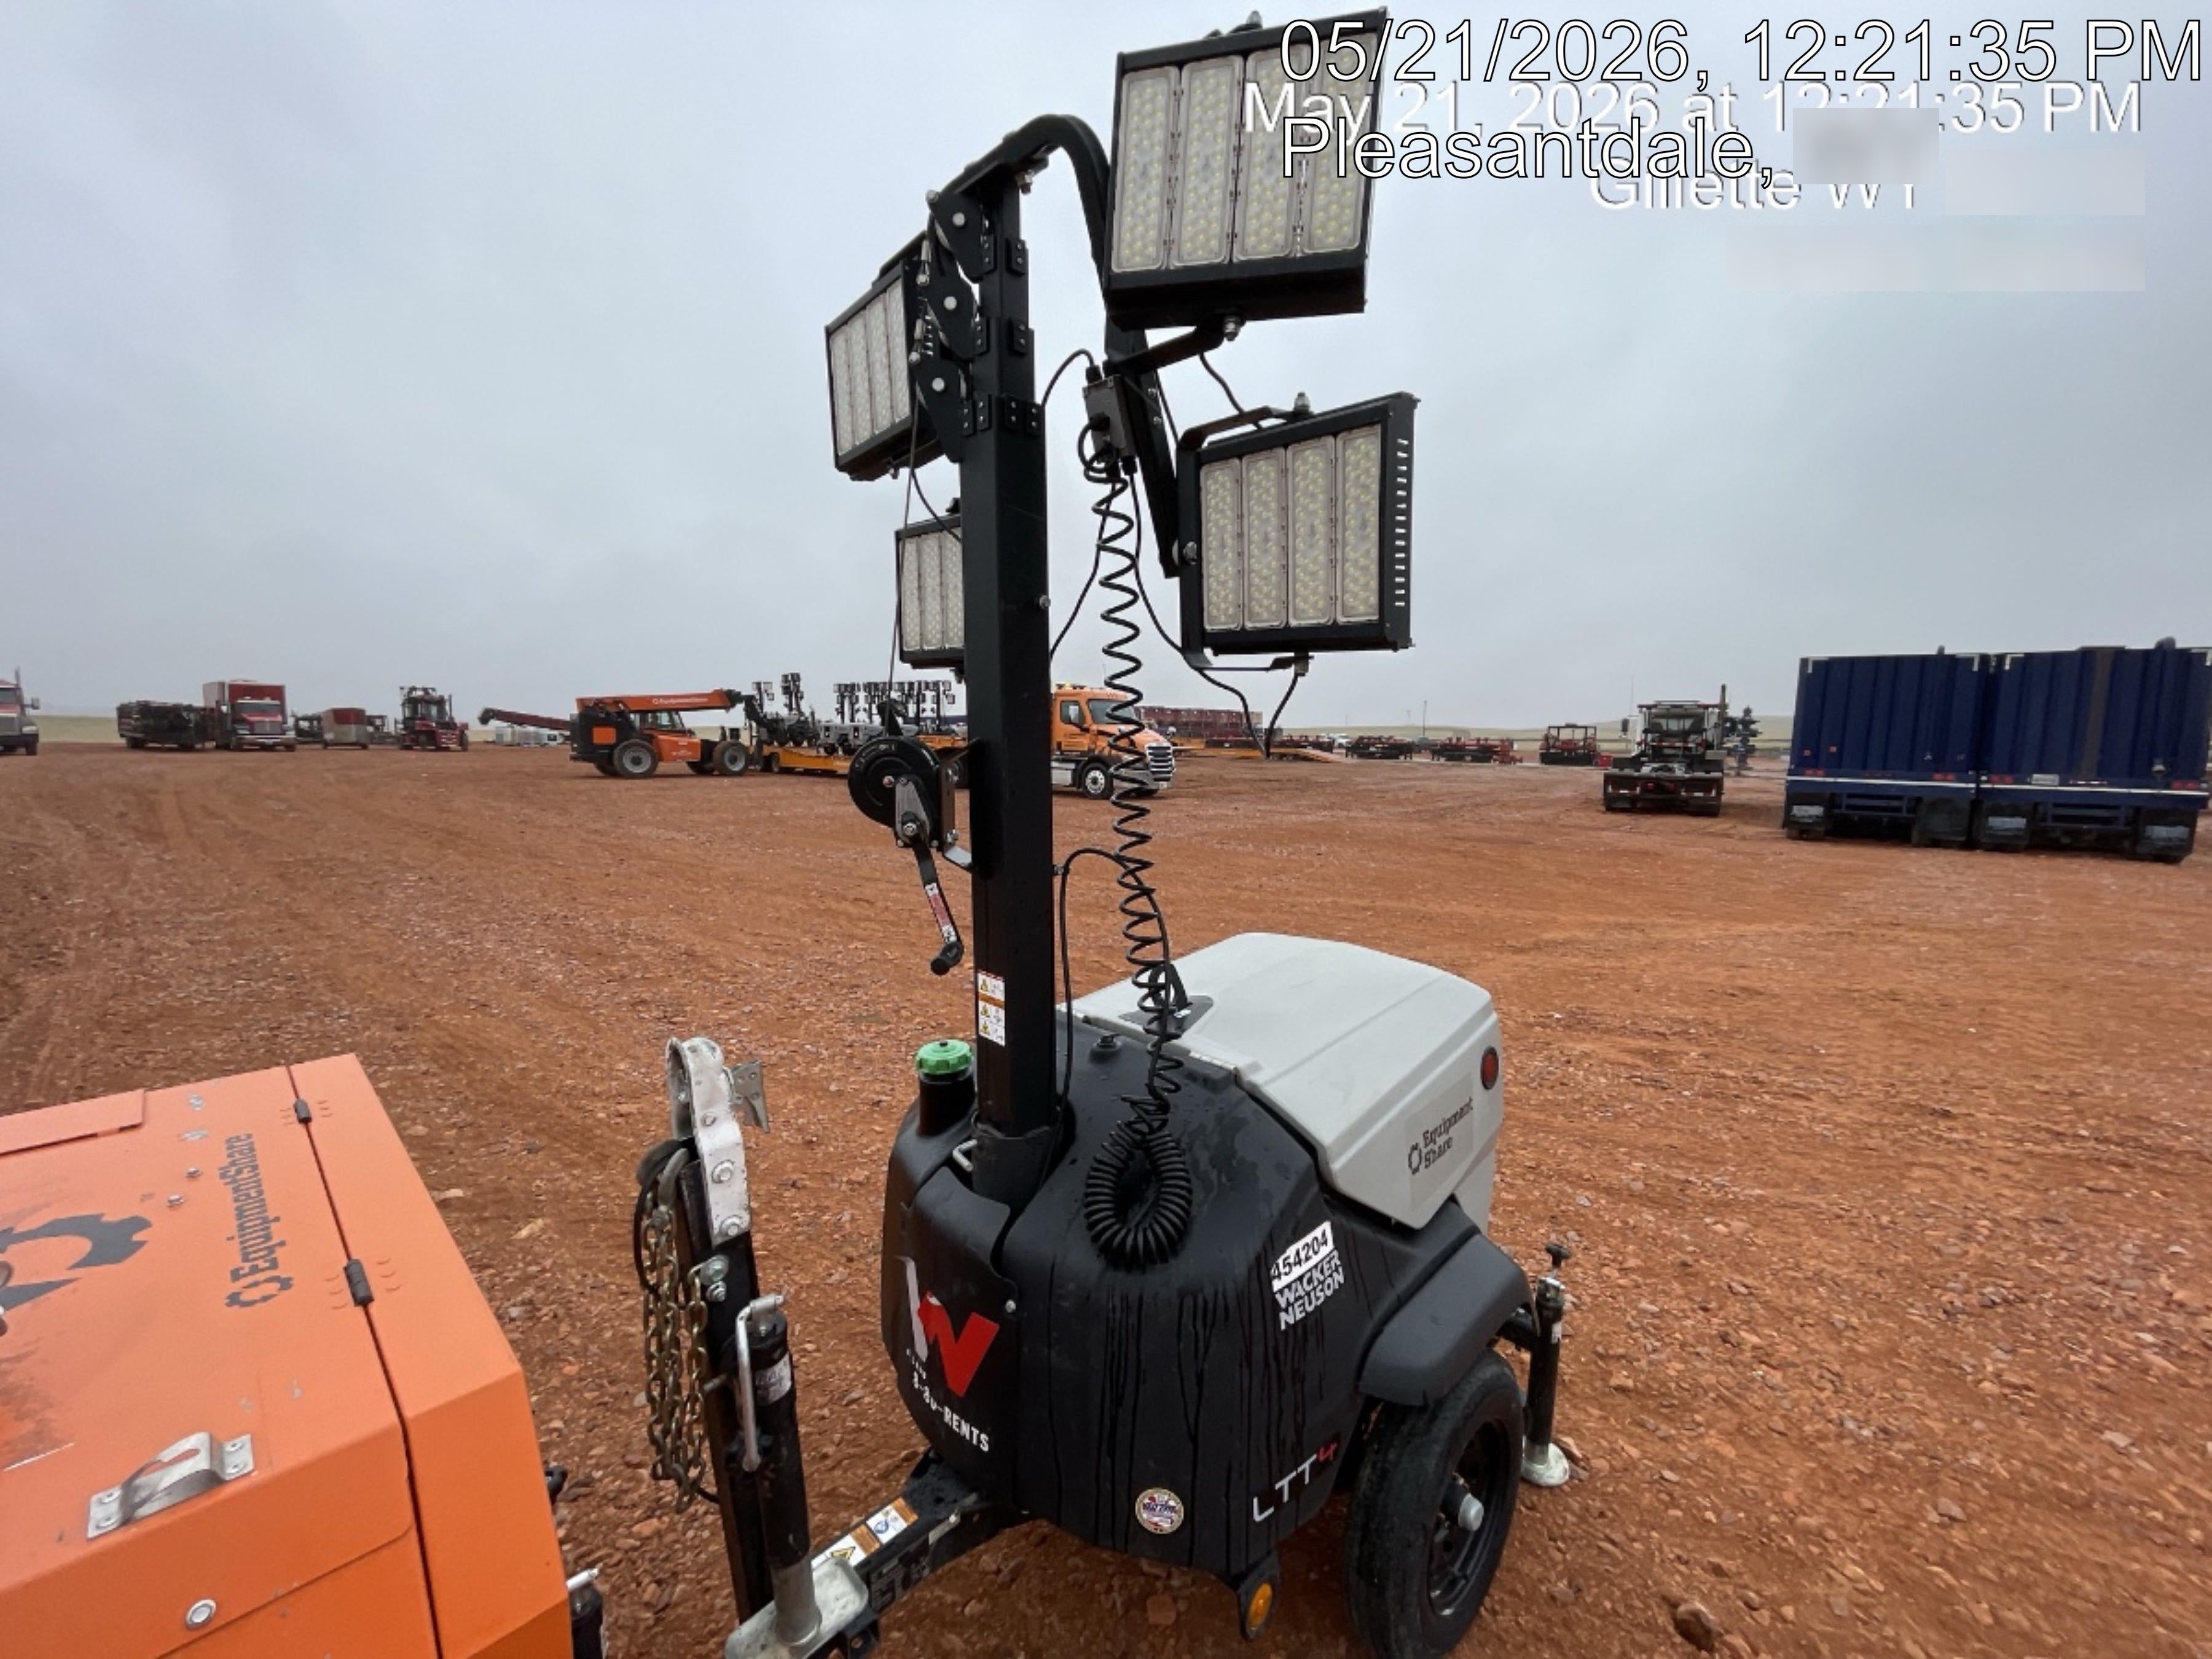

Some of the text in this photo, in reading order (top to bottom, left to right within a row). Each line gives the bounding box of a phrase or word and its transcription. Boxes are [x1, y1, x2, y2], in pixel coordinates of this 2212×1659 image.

[1271, 1228, 1328, 1282] 454204
[1275, 1249, 1341, 1309] WACKER
[1279, 1265, 1344, 1332] NEUSON
